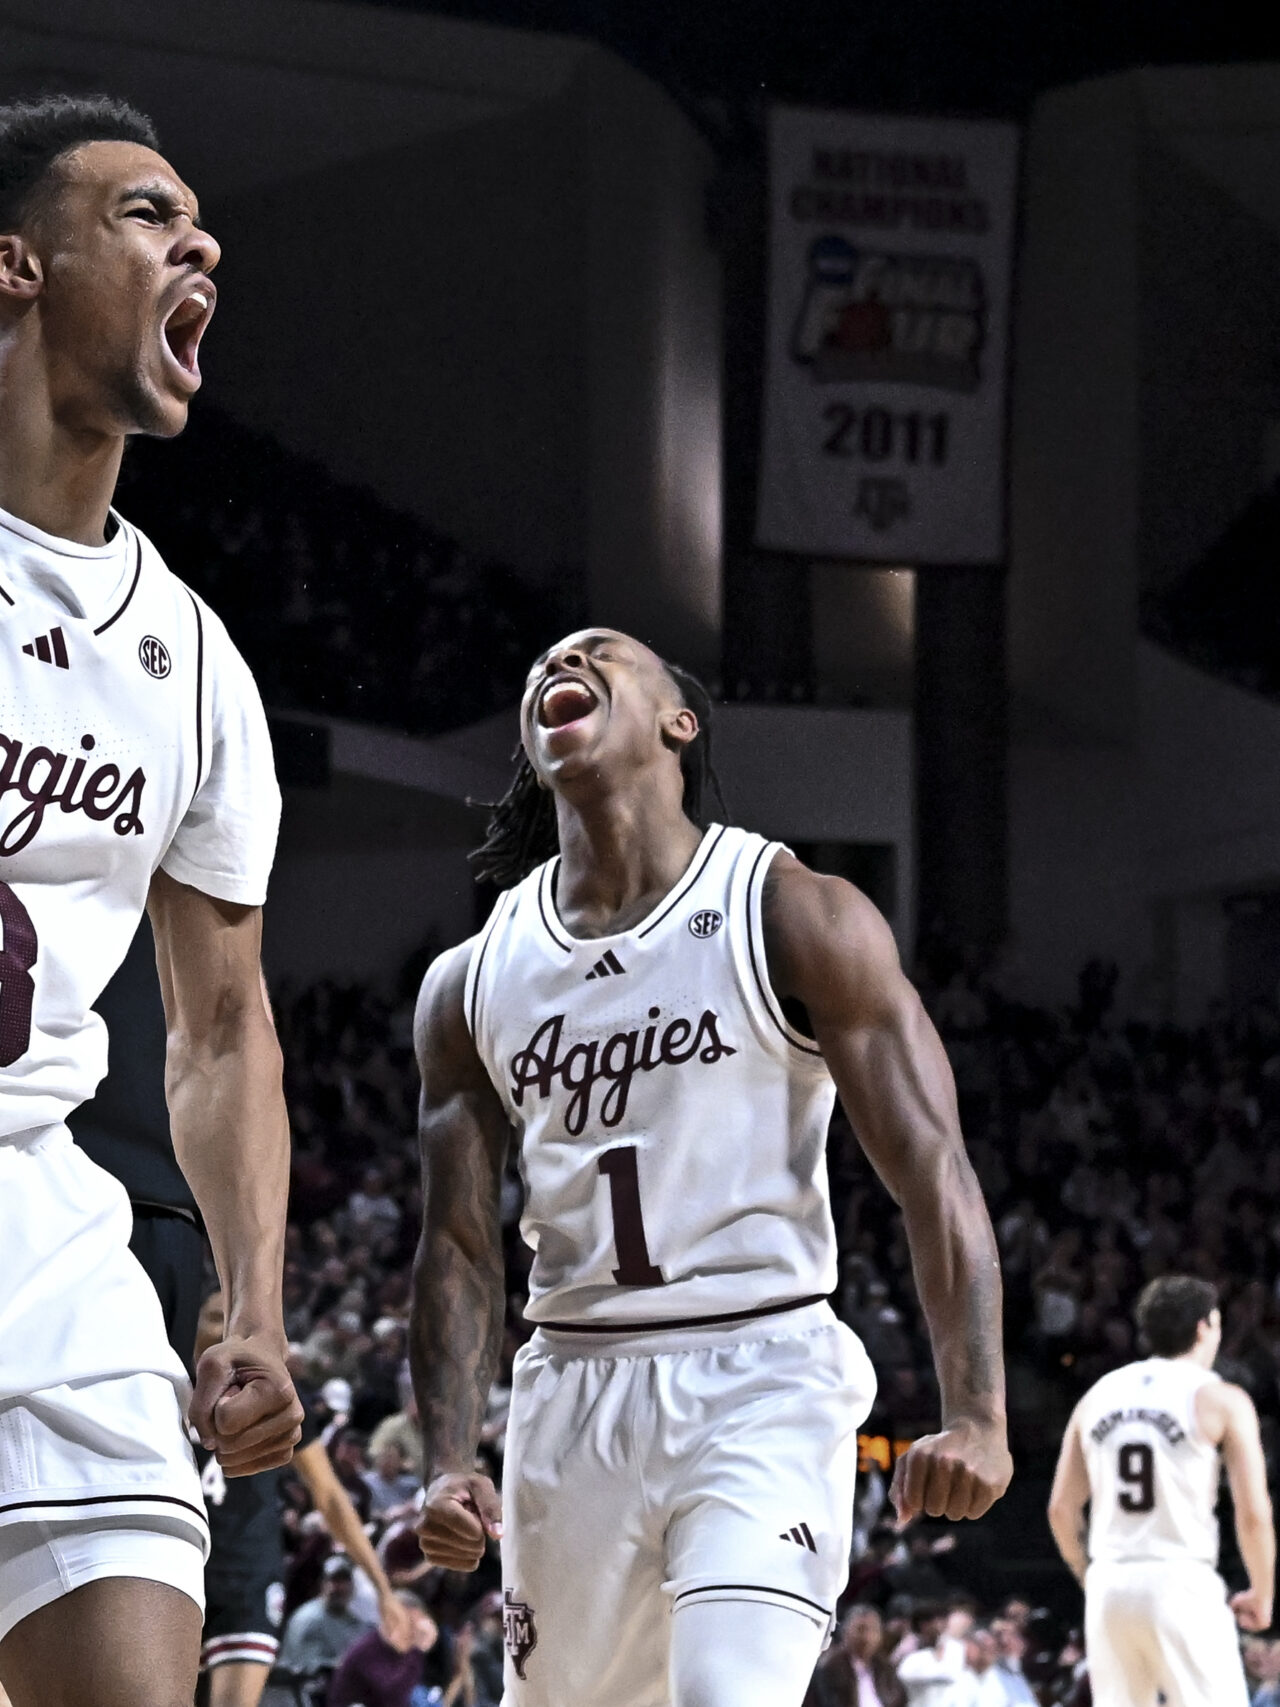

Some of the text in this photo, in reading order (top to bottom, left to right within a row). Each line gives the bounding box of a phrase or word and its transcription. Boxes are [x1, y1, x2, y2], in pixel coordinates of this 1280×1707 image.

[821, 401, 950, 468] 2011
[142, 639, 168, 675] SEC
[693, 912, 720, 935] SEC
[511, 1007, 736, 1136] Aggies
[598, 1146, 666, 1286] 1
[1118, 1442, 1155, 1514] 9
